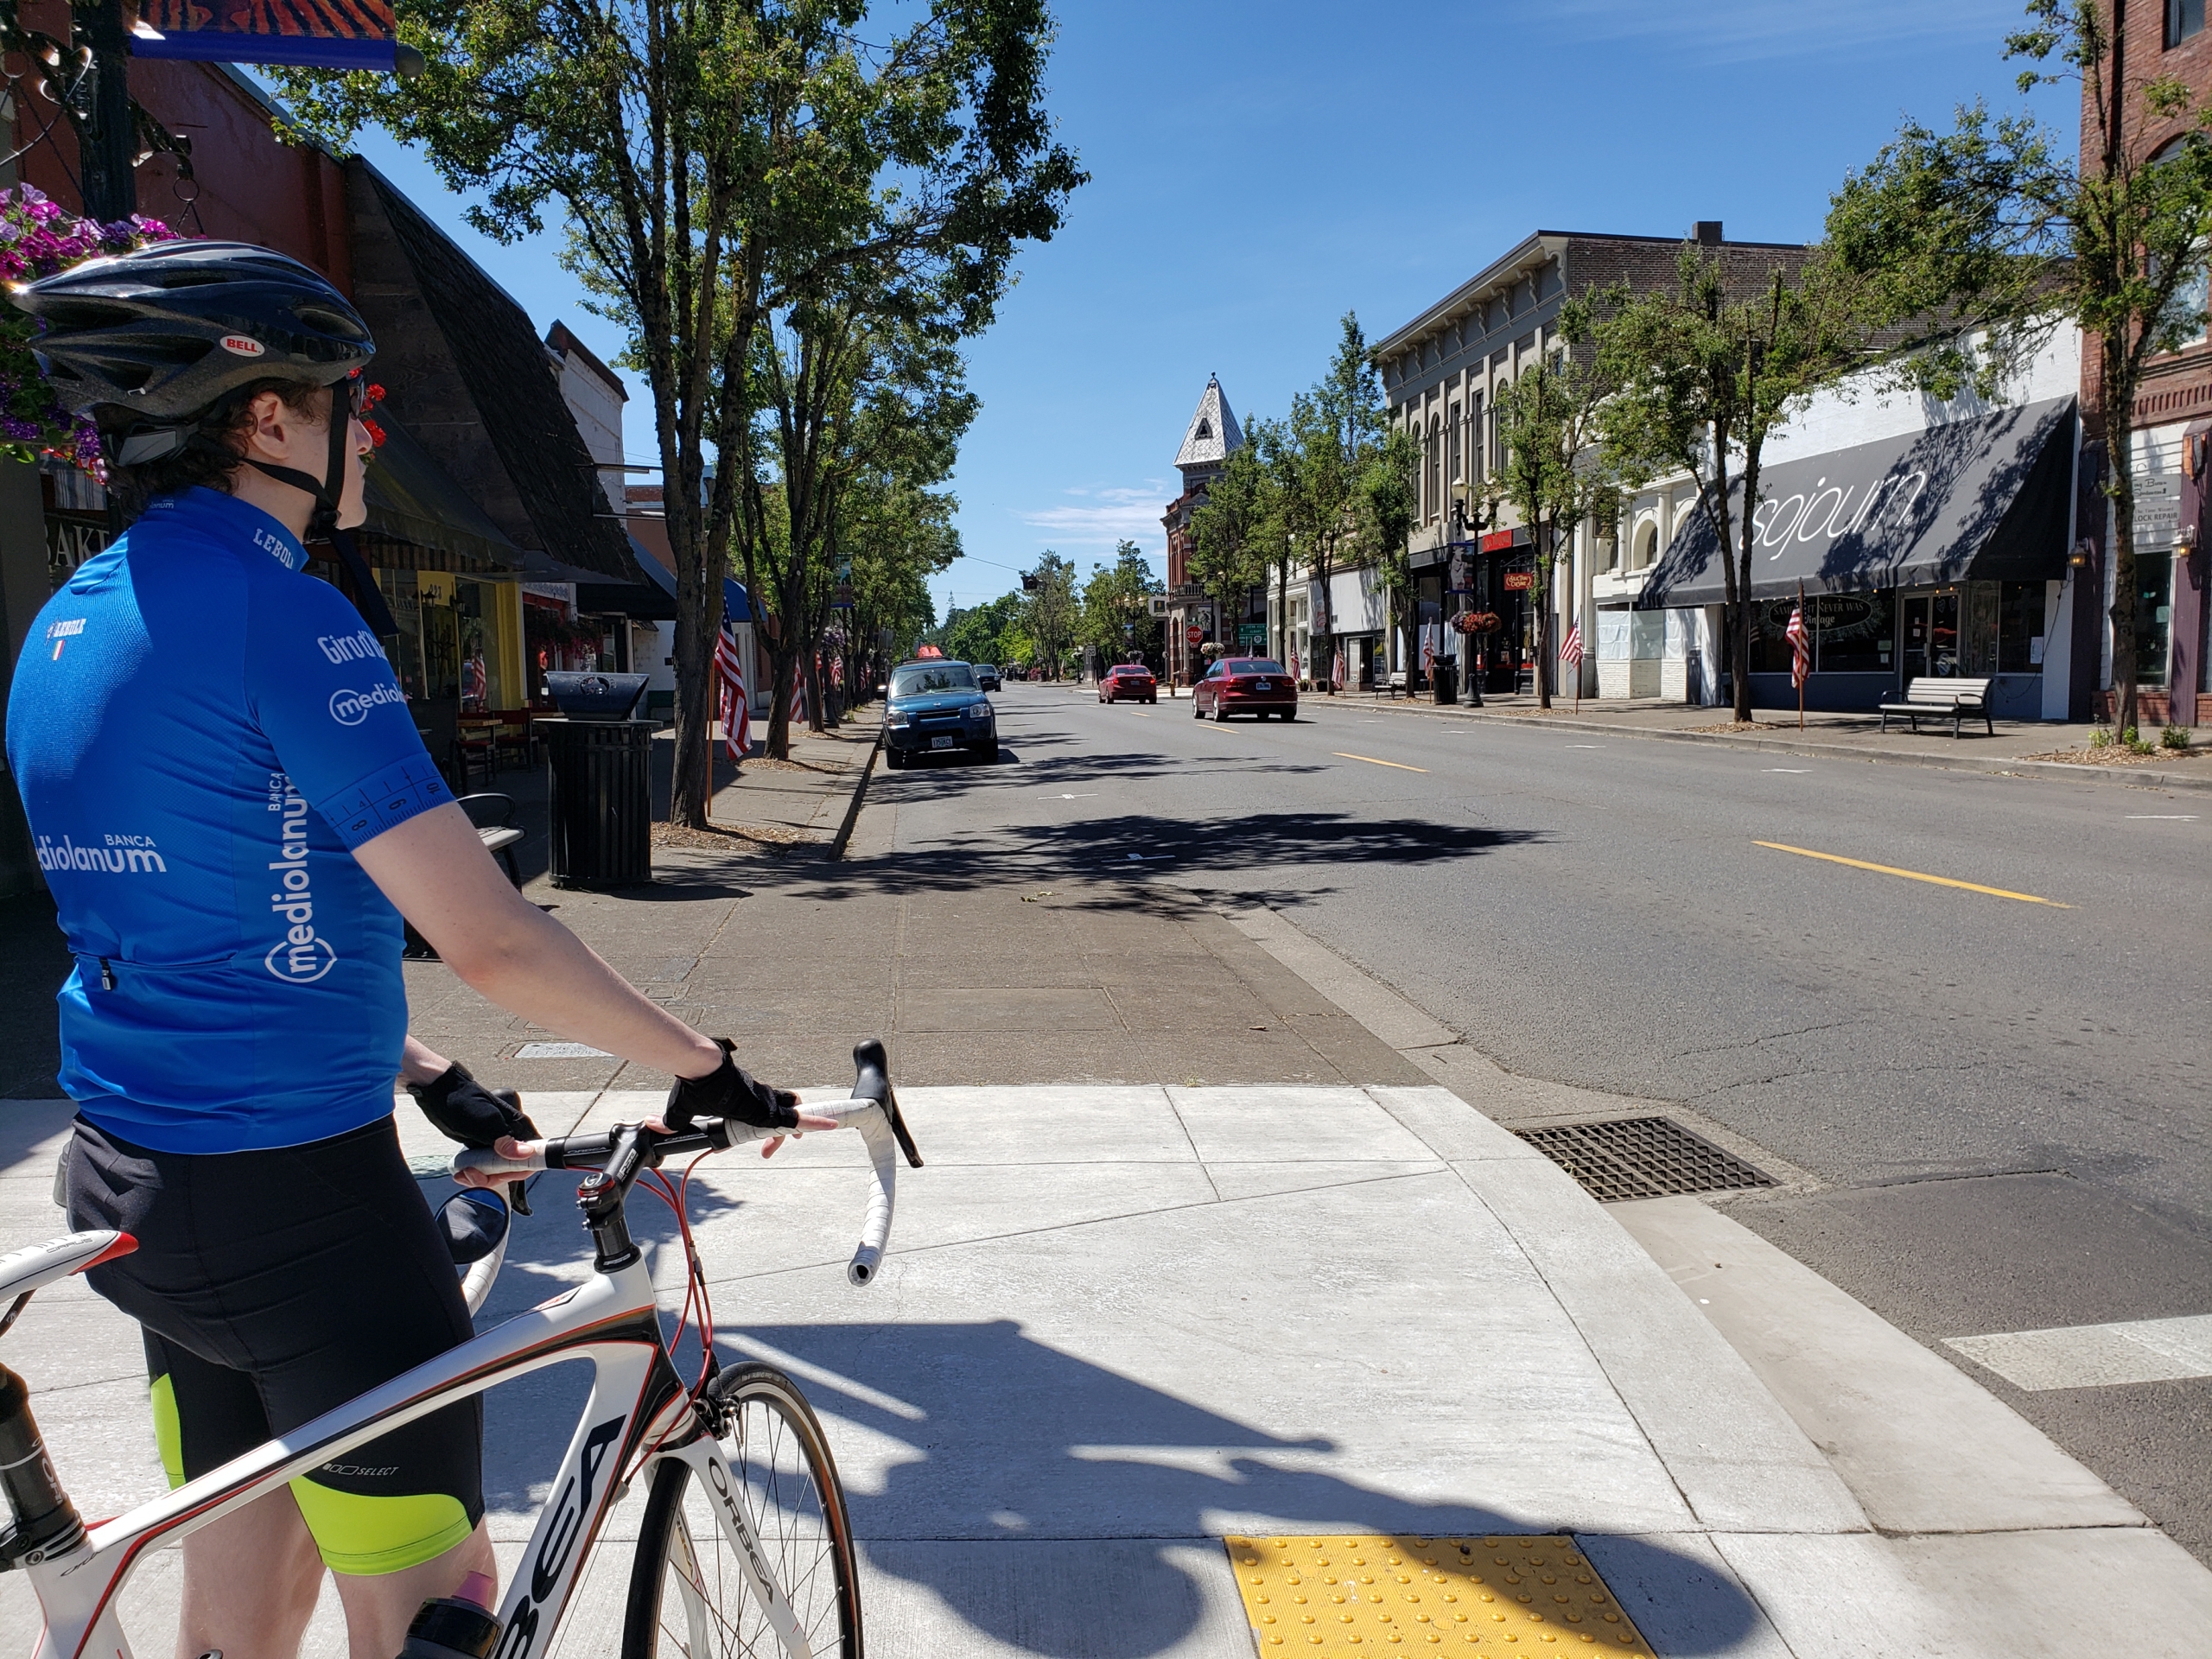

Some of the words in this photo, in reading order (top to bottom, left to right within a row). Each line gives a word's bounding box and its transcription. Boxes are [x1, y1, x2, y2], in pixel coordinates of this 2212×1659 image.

[226, 338, 257, 353] BELL
[1738, 470, 1926, 561] sojourn
[2153, 512, 2177, 520] REPAIR
[45, 522, 110, 567] AKE
[253, 528, 295, 569] LEBOL
[1846, 601, 1864, 612] WAS
[317, 634, 365, 664] Giro
[268, 772, 285, 812] BANCA
[38, 834, 168, 874] diolanum
[104, 834, 157, 848] BANCA
[357, 1466, 399, 1476] SELECT
[708, 1456, 774, 1605] ORBEA
